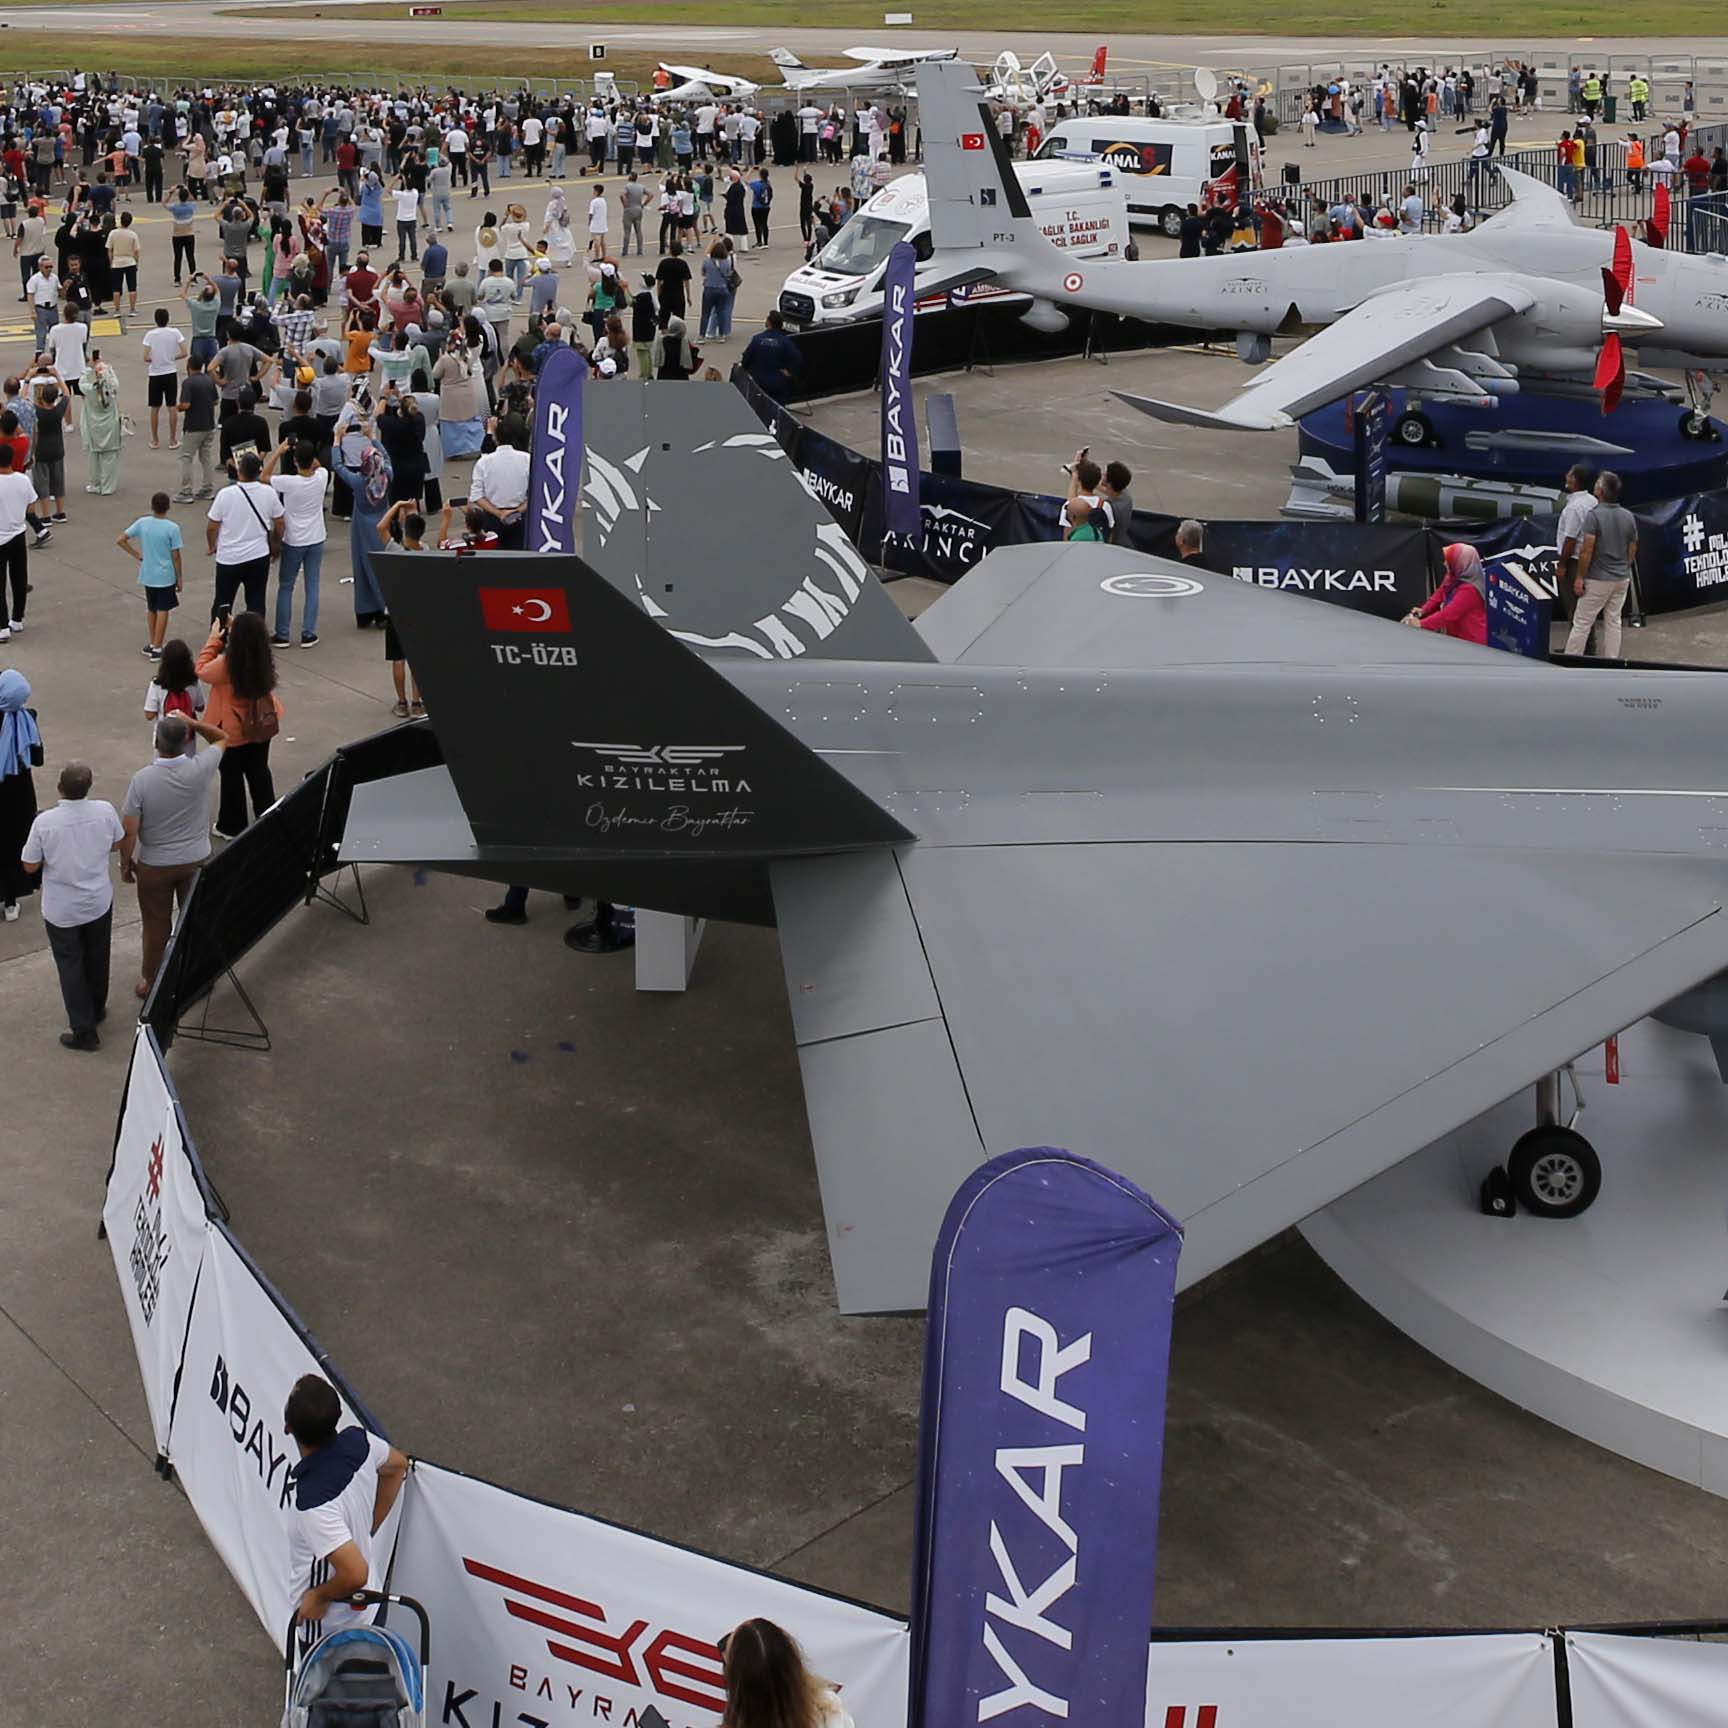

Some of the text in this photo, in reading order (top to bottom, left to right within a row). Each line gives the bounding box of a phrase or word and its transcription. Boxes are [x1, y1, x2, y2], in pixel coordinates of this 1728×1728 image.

[993, 233, 1015, 243] PT-3
[1040, 222, 1065, 237] AĞLIK
[888, 285, 907, 462] BAYKAR
[539, 402, 570, 553] YKAR
[924, 515, 976, 540] RAKTAR
[1258, 567, 1398, 592] BAYKAR
[490, 642, 579, 666] TC-ÖZB
[576, 773, 752, 793] KIZILELMA
[604, 765, 720, 776] BAYRAKTAR
[229, 1382, 298, 1511] BAYK
[508, 1663, 640, 1728] BAYRA
